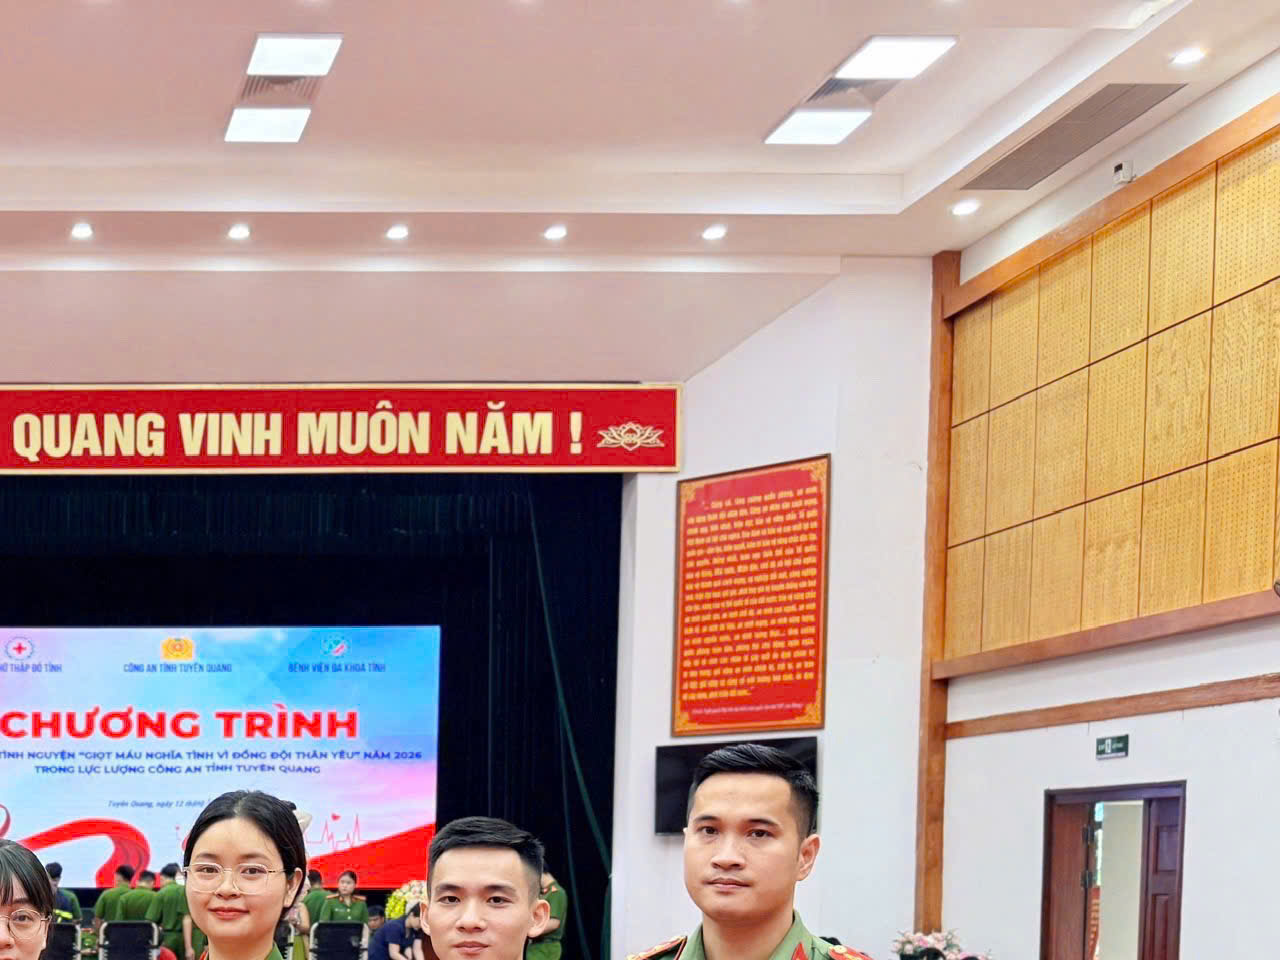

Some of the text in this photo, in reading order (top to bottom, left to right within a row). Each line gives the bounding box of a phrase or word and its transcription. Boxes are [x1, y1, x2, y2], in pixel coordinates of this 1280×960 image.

[13, 413, 165, 462] QUANG
[178, 413, 282, 456] VINH
[297, 400, 430, 455] MUÔN
[445, 401, 552, 455] NĂM
[146, 664, 157, 673] AN
[206, 664, 232, 673] QUANG
[0, 703, 358, 738] CHƯƠNG TRÌNH
[28, 749, 75, 761] NGUYỆN
[115, 749, 142, 759] MÁU
[146, 749, 182, 759] NGHĨA
[187, 749, 213, 759] TÌNH
[217, 749, 229, 759] VÌ
[232, 748, 267, 759] ĐỒNG
[271, 749, 291, 761] ĐỘI
[295, 749, 328, 759] THÂN
[363, 749, 391, 759] NĂM
[35, 765, 74, 774] TRONG
[78, 765, 101, 776] LỰC
[104, 765, 145, 776] LƯỢNG
[148, 764, 182, 774] CÔNG
[185, 766, 202, 774] AN
[236, 763, 275, 772] TUYÊN
[279, 765, 320, 774] QUANG
